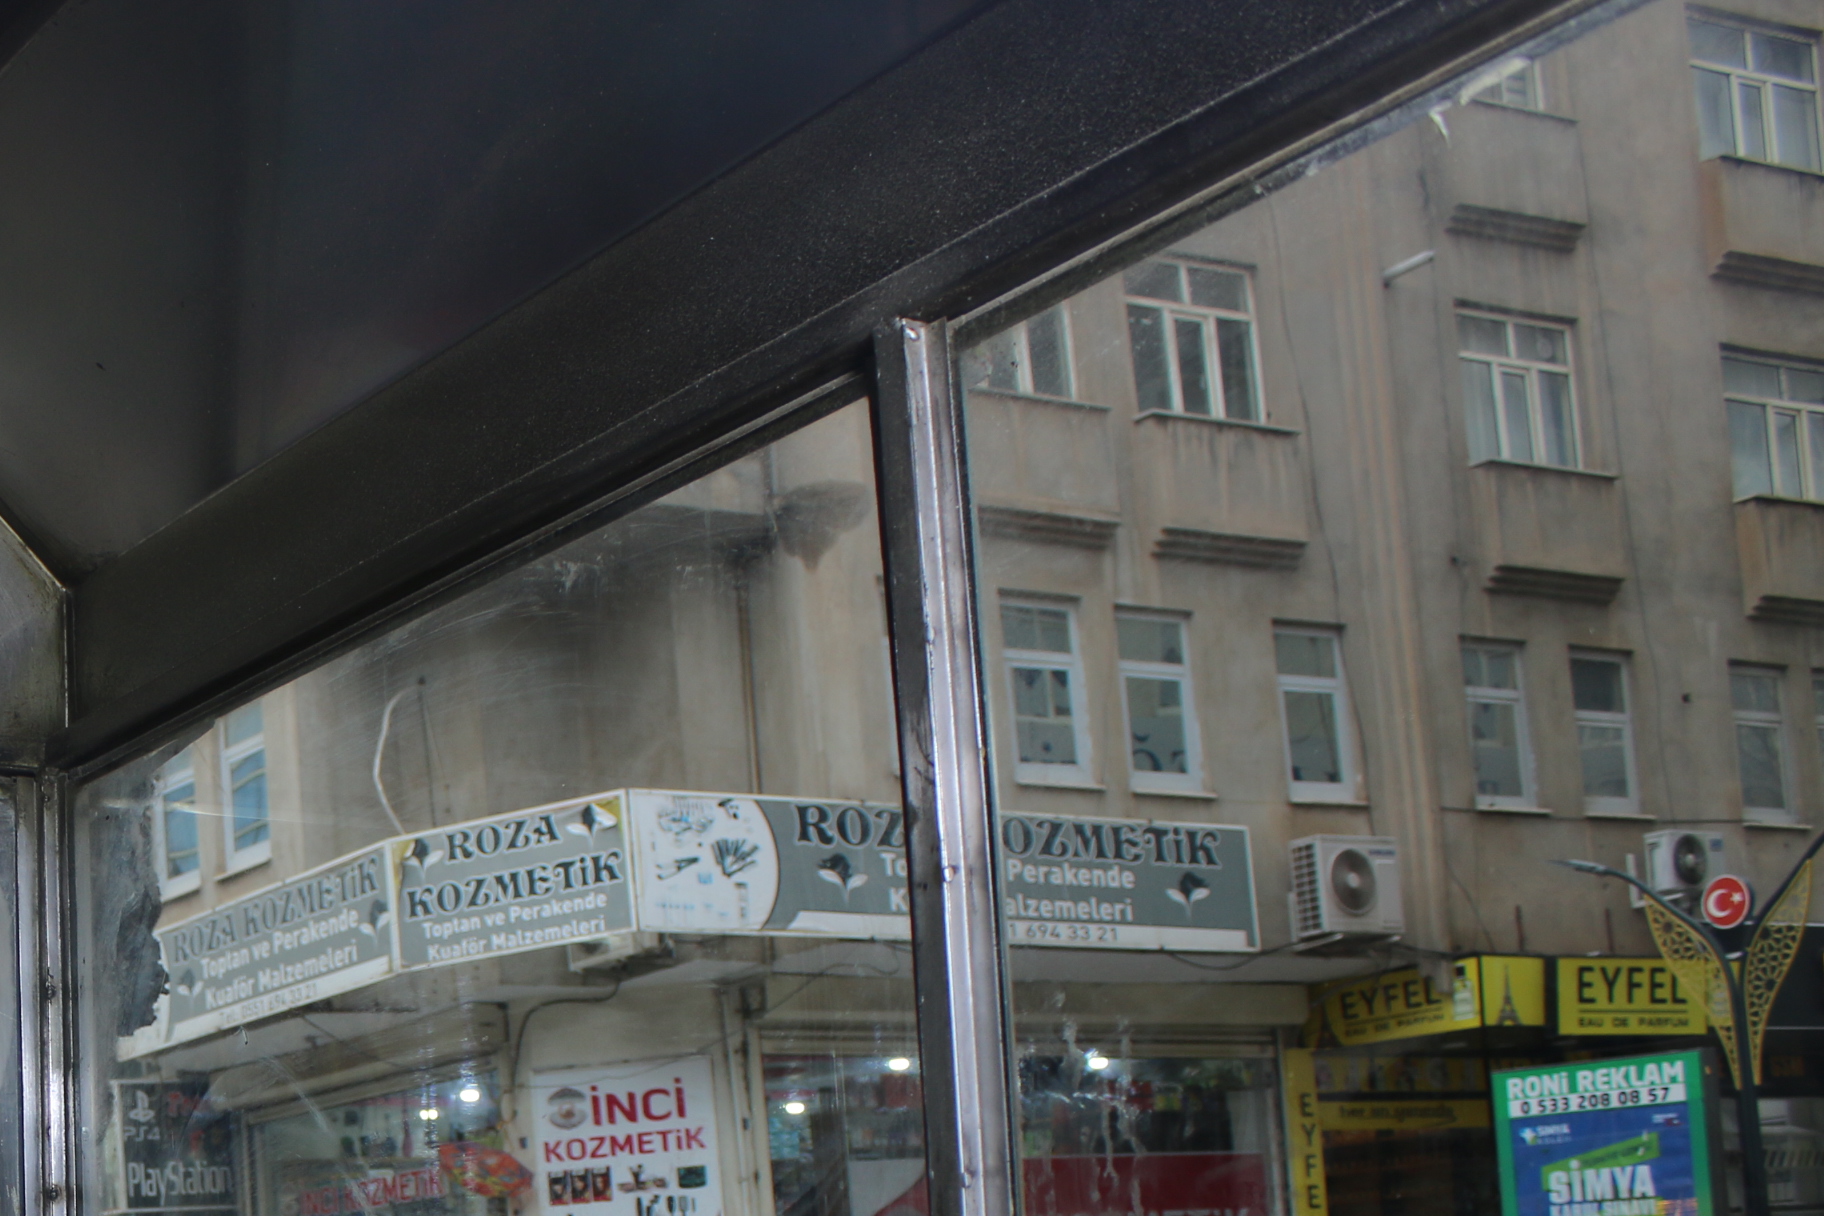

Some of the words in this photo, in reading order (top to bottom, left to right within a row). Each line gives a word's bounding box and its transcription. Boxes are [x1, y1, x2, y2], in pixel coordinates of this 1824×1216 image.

[446, 813, 561, 861] ROZA
[794, 804, 906, 848] ROZ
[1006, 858, 1136, 889] Perakende
[422, 914, 482, 941] Toptan
[484, 909, 506, 928] ve
[509, 892, 608, 924] Perakende
[1005, 892, 1134, 923] alzemeleri
[173, 917, 238, 965] ROZA
[201, 949, 251, 979] Toptan
[252, 939, 271, 959] ve
[273, 907, 360, 952] Perakende
[428, 937, 487, 963] Kuaför
[490, 914, 607, 951] Malzemeleri
[1026, 923, 1061, 940] 694
[1065, 925, 1091, 942] 33
[1097, 926, 1119, 943] 21
[205, 974, 255, 1011] Kuaför
[257, 938, 359, 993] Malzemeleri
[1577, 965, 1687, 1004] EYFEL
[1340, 975, 1443, 1020] EYFEL
[1577, 1060, 1685, 1093] REKLAM
[1521, 1101, 1530, 1115] 0
[1537, 1097, 1570, 1114] 533
[1578, 1093, 1612, 1110] 208
[1618, 1089, 1640, 1106] 08
[1648, 1086, 1670, 1103] 57
[123, 1125, 161, 1143] PS4
[127, 1159, 236, 1207] PlayStation
